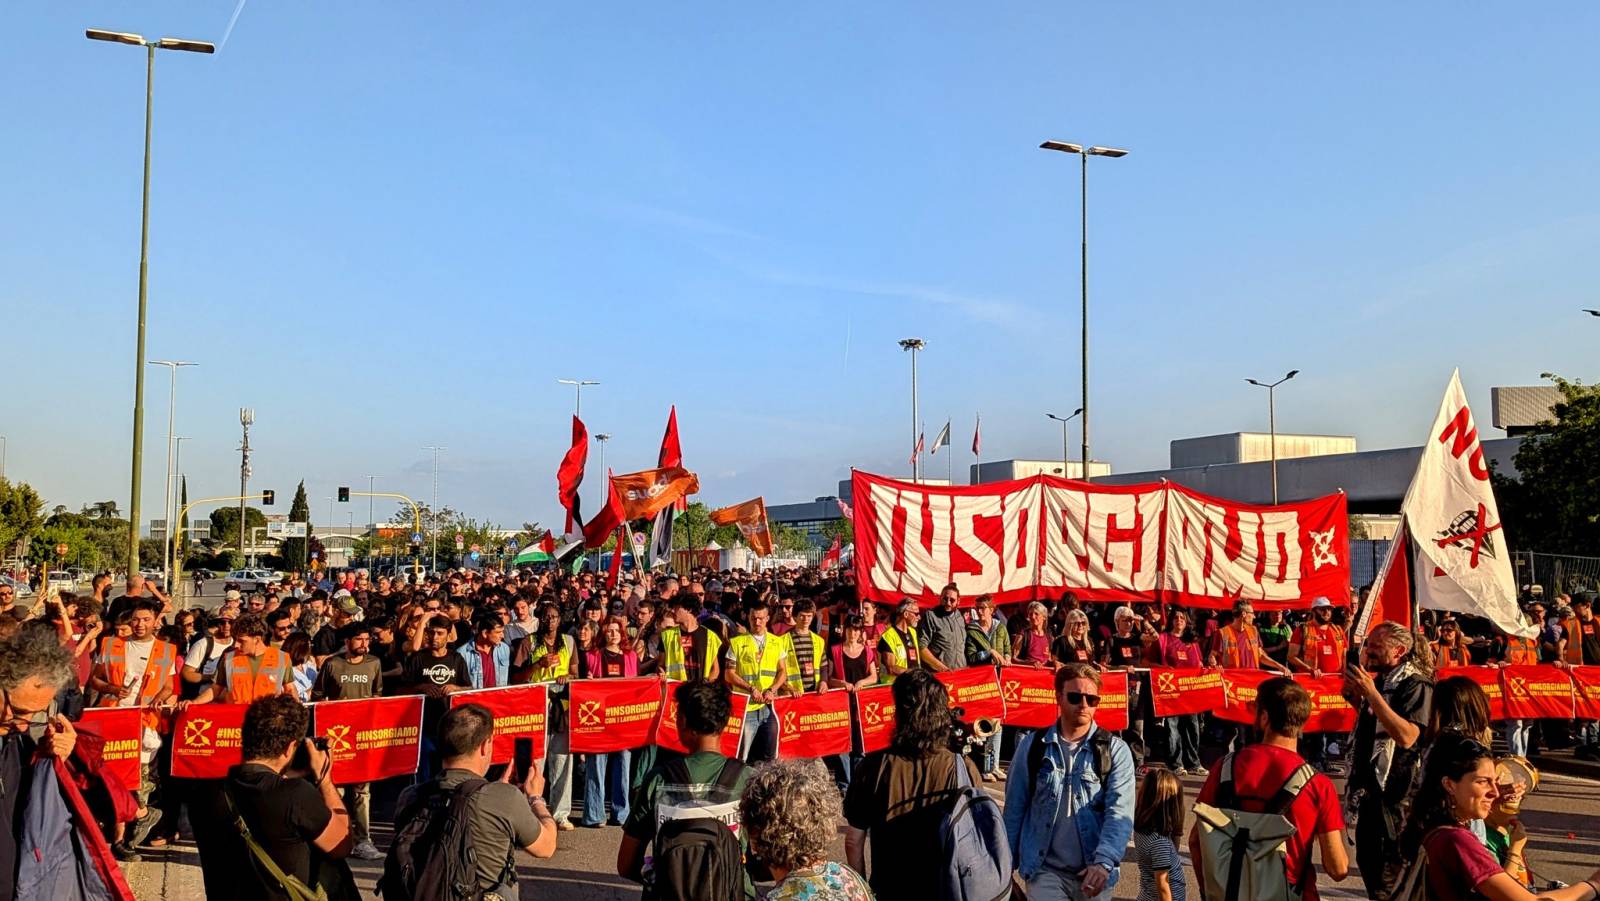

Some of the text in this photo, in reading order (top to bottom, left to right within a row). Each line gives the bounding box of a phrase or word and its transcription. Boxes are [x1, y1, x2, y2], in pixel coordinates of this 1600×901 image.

[870, 481, 1301, 600] INSORGIAMO
[423, 668, 456, 678] Hard Rock
[800, 710, 848, 724] #INSORGIAMO
[356, 726, 418, 742] #INSORGIAMO
[356, 741, 369, 750] CON
